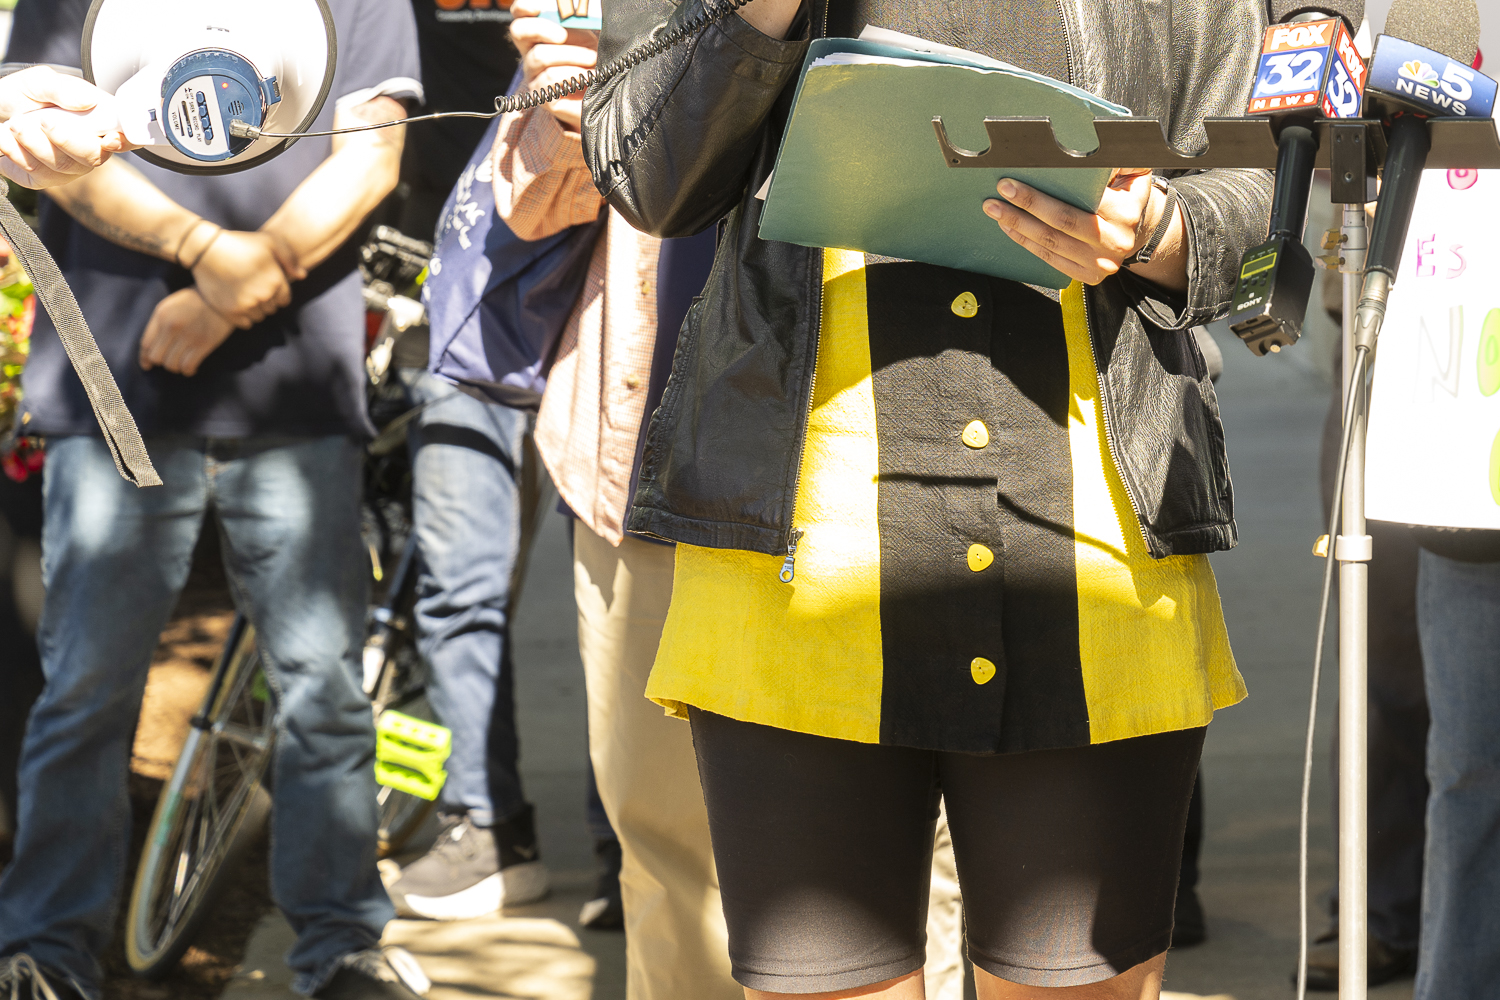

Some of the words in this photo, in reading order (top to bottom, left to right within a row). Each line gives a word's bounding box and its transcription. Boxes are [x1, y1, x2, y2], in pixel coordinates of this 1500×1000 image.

[1269, 23, 1329, 51] FOX
[1256, 50, 1324, 95] 32
[1338, 31, 1365, 90] FOX
[1253, 93, 1315, 110] NEWS
[1395, 77, 1468, 117] NEWS
[1439, 61, 1475, 102] 5
[1236, 296, 1263, 311] SONY
